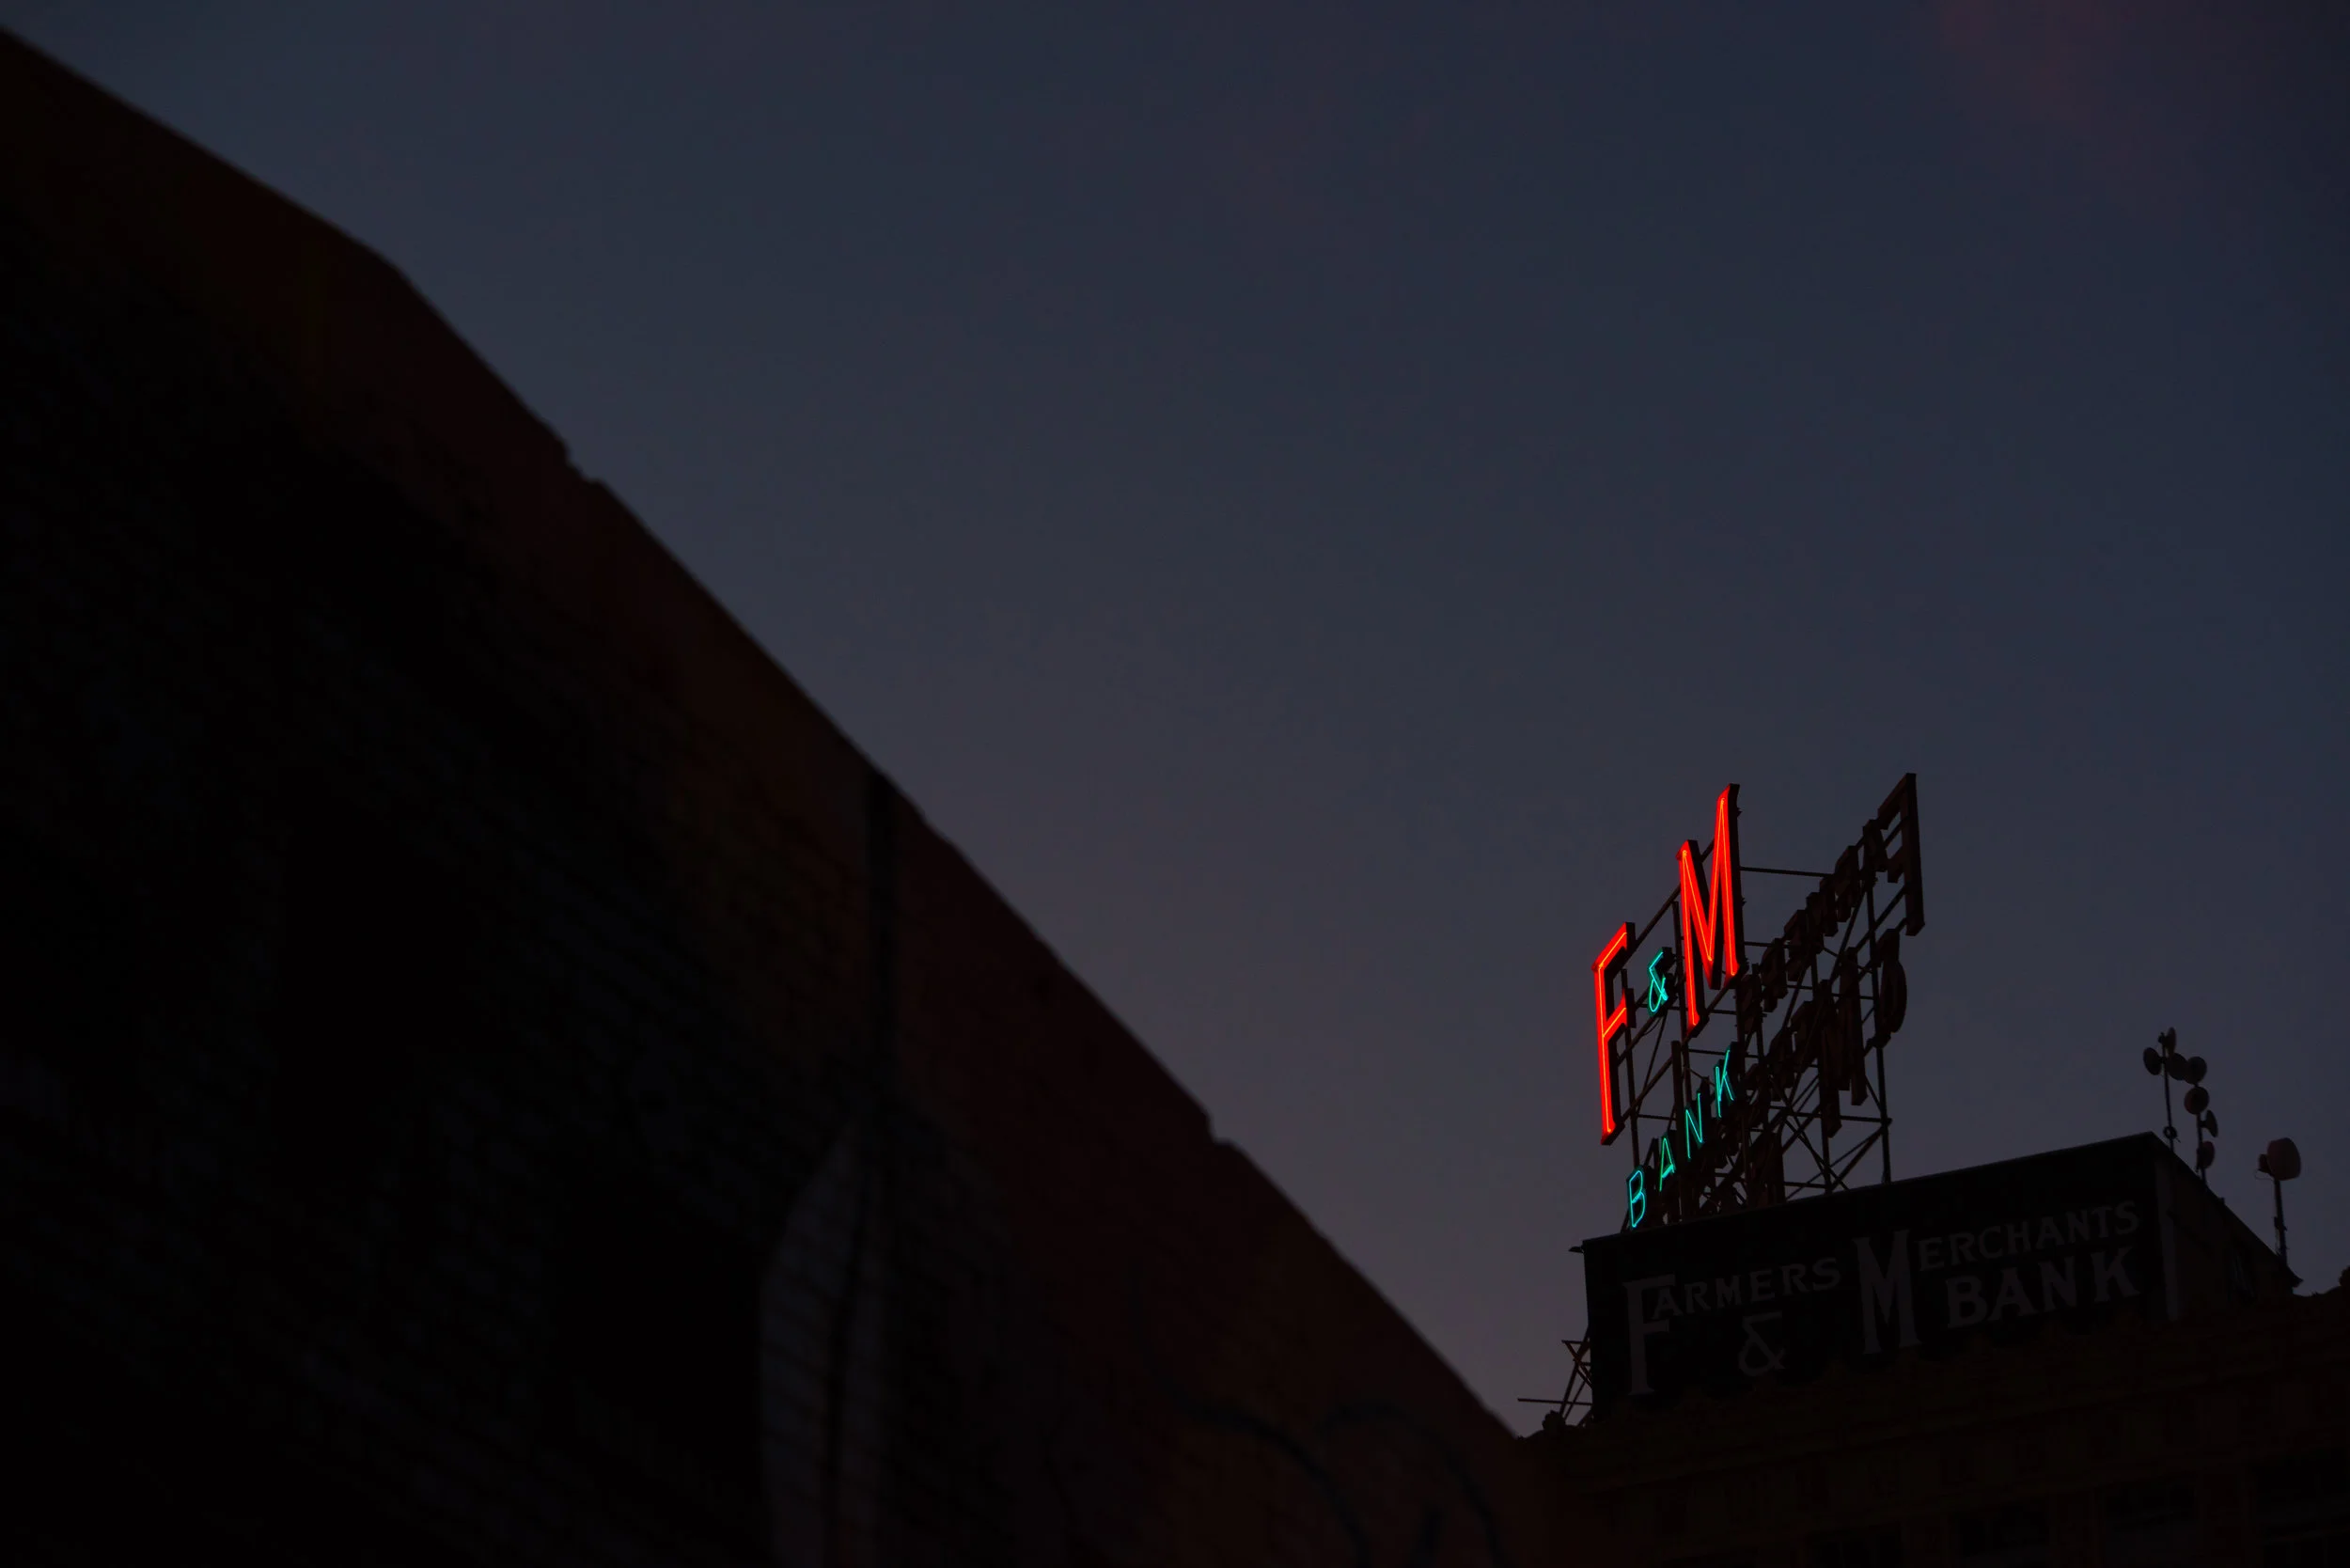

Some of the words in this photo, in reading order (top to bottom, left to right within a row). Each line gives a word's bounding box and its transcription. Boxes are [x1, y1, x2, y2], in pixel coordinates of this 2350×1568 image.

[1627, 1043, 1738, 1229] BANK
[1622, 1258, 1842, 1395] FARMERS
[1736, 1309, 1787, 1378] &
[1853, 1200, 2141, 1355] MERCHANTS
[1945, 1245, 2141, 1330] BANK
